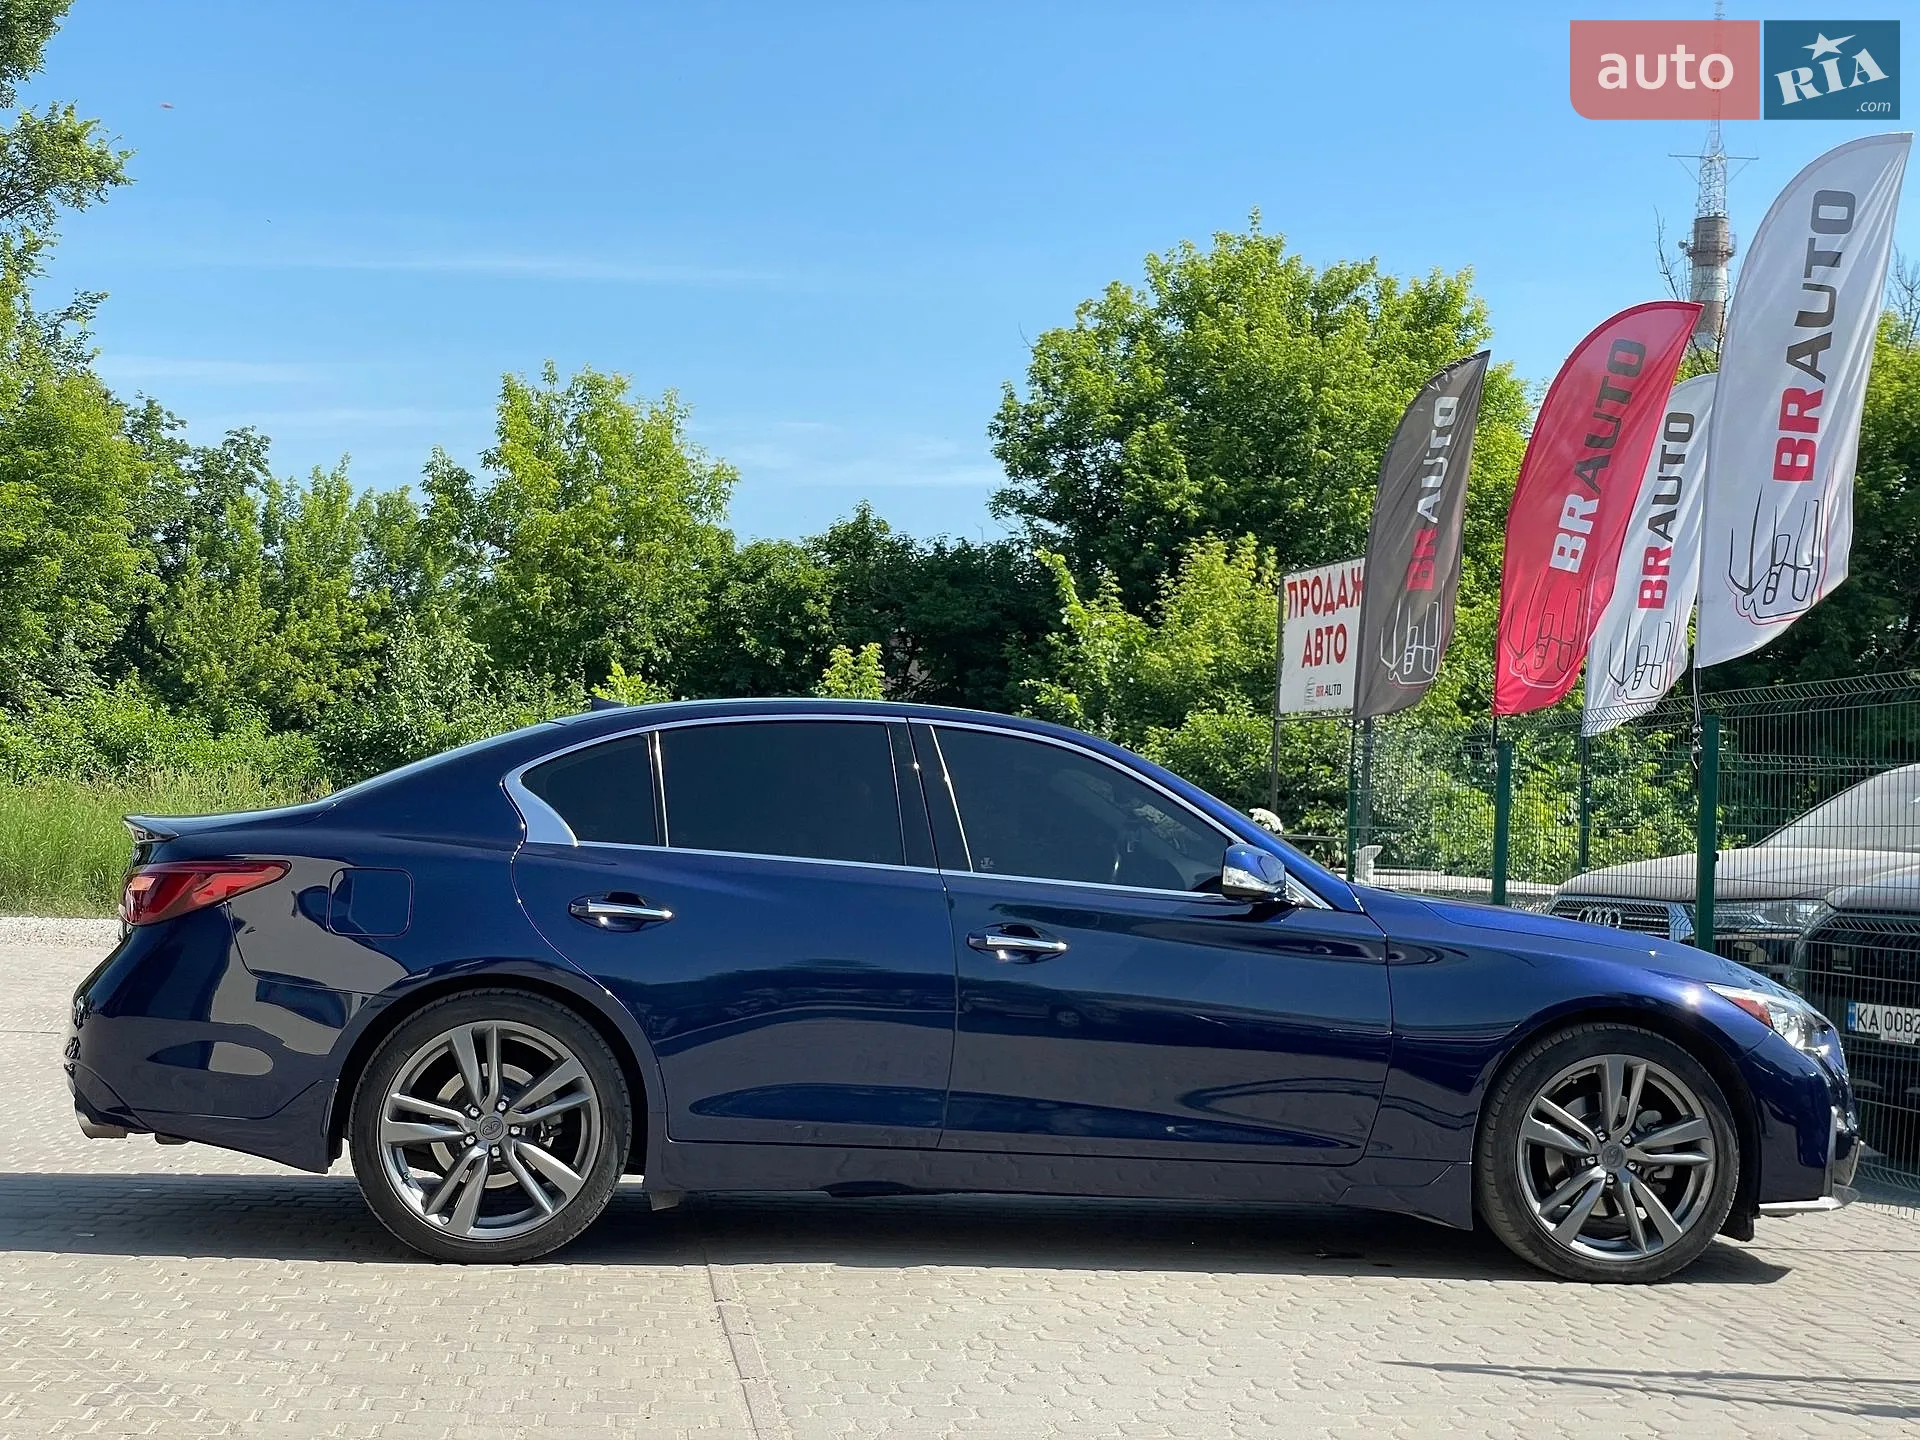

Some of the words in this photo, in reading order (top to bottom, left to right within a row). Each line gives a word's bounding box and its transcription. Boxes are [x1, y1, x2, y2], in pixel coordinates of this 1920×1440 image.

[1773, 189, 1857, 482] BRAUTO
[1550, 338, 1647, 574] BRAUTO
[1637, 411, 1696, 610] BRAUTO
[1301, 623, 1348, 668] АВТО
[1857, 1007, 1879, 1031] KA
